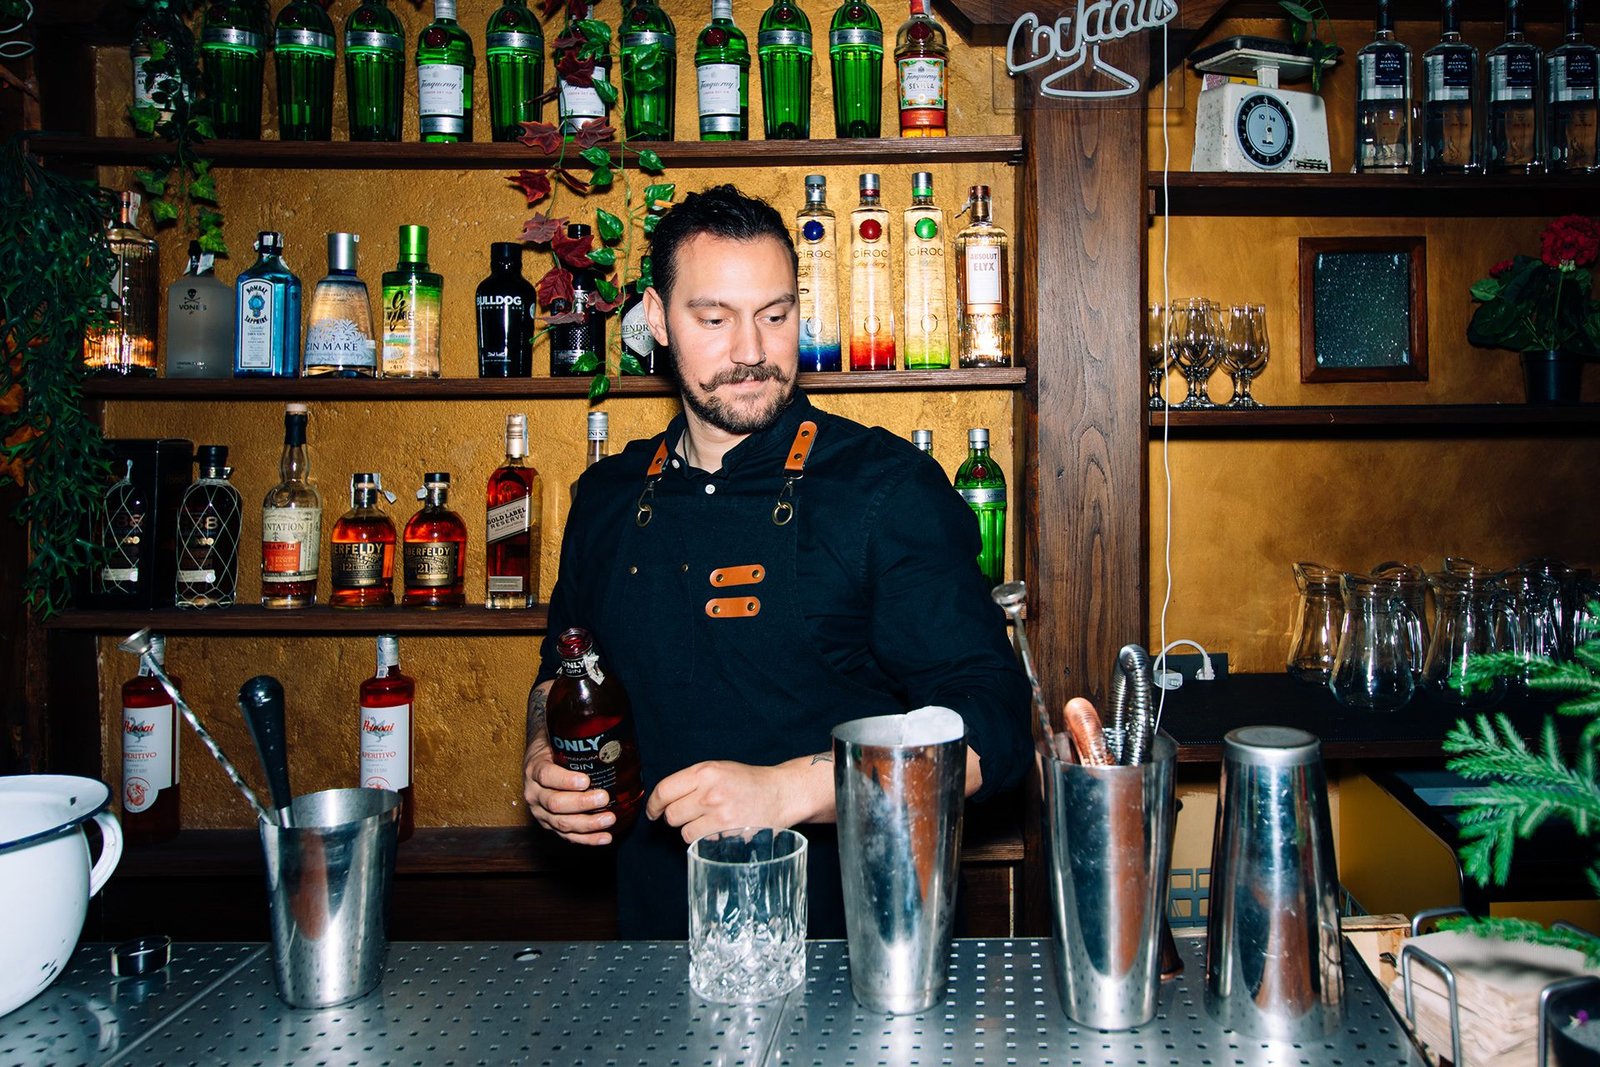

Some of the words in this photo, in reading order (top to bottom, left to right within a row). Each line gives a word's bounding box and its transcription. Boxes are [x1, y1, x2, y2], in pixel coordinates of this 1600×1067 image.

[421, 79, 457, 90] Tanqueray
[908, 82, 935, 90] SEVILLA
[973, 262, 995, 271] ELYX
[245, 285, 268, 295] BOMBAY
[476, 296, 522, 306] BULLDOG
[244, 315, 269, 325] SAPPHIRE
[622, 324, 650, 333] HENDR
[306, 342, 320, 351] GIN
[322, 342, 358, 351] MARE
[486, 515, 505, 525] GOLD
[504, 507, 527, 519] LABEL
[490, 513, 525, 529] RESERVE
[334, 543, 383, 554] ERFELDY
[342, 562, 353, 572] 12
[417, 563, 430, 573] 21
[561, 660, 585, 669] ONLY
[553, 735, 601, 752] ONLY
[569, 763, 594, 771] GIN
